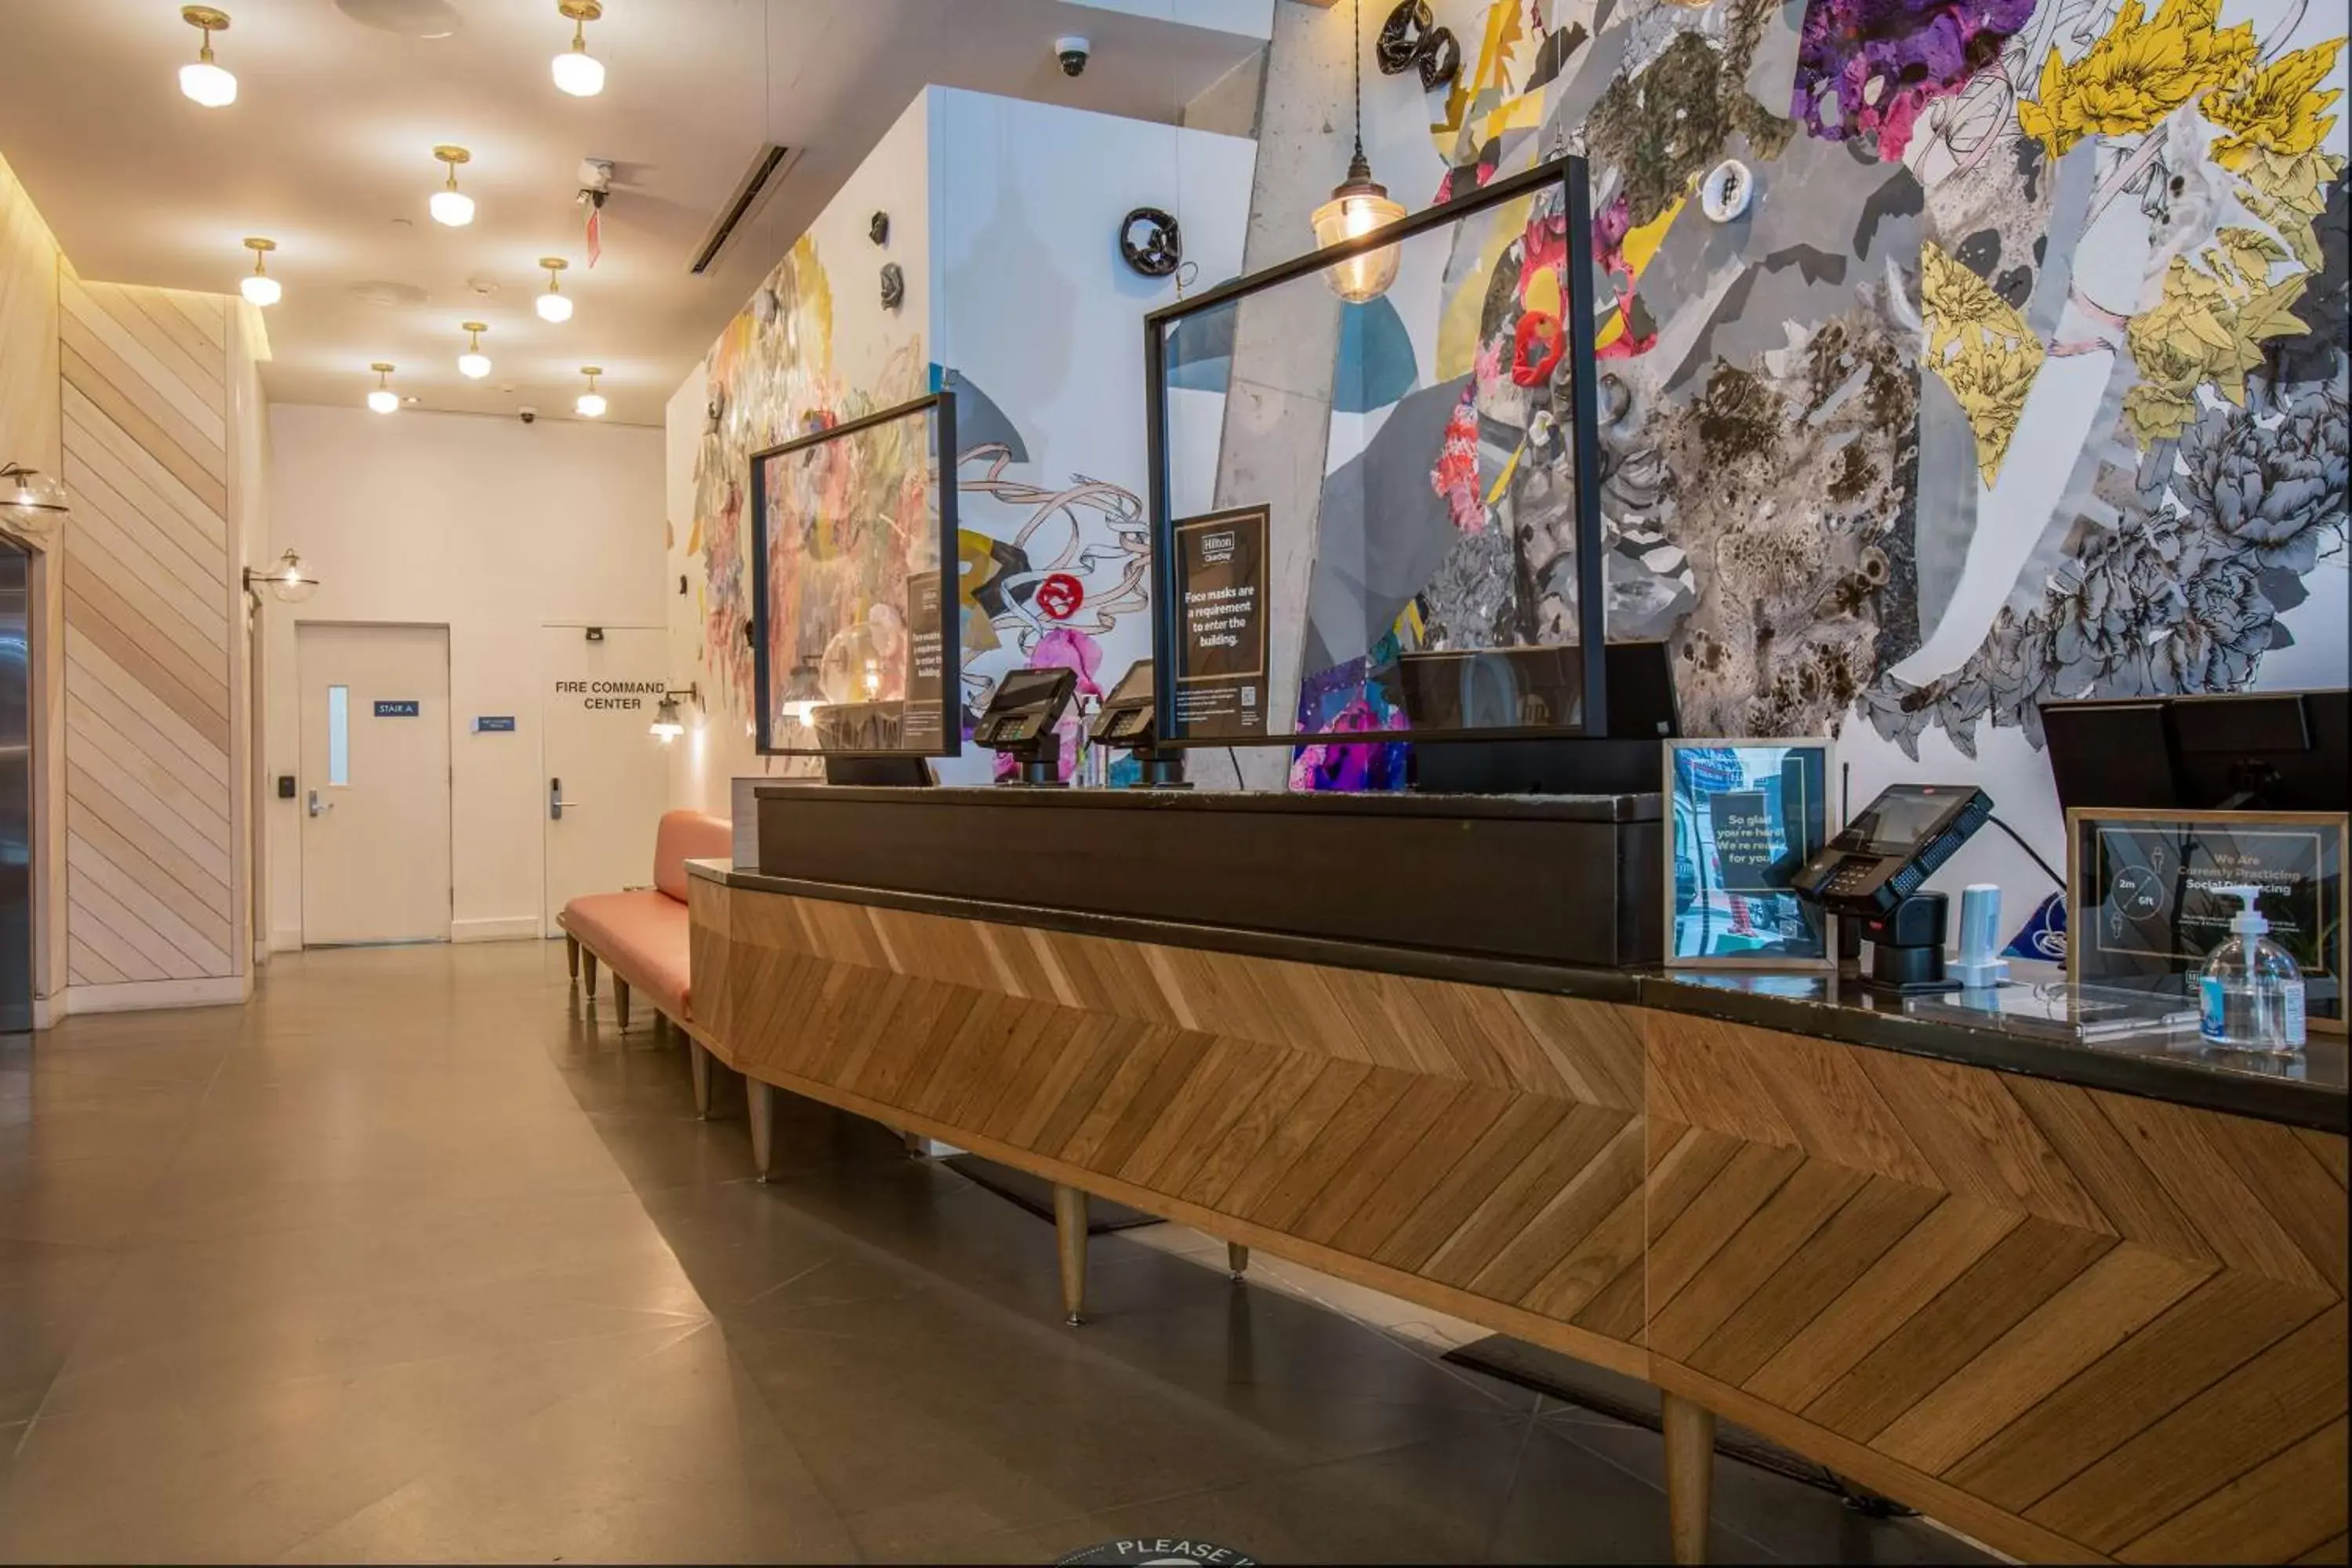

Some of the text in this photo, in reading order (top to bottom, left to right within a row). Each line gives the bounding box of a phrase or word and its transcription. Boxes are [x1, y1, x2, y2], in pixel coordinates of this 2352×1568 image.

[1185, 586, 1254, 603] Face masks are
[1188, 601, 1250, 619] a requirement
[1192, 616, 1246, 632] to enter the
[556, 681, 664, 694] FIRE COMMAND
[584, 699, 641, 710] CENTER
[1729, 815, 1772, 826] So glad
[1717, 826, 1753, 840] you're
[1717, 840, 1751, 851] We're
[1729, 853, 1746, 862] for
[2214, 853, 2260, 865] We Are
[2177, 866, 2301, 882] Currently Practicing
[2119, 879, 2136, 888] 2m
[2186, 879, 2292, 896] Social Dncing
[2139, 896, 2154, 906] 6ft
[1116, 1538, 1232, 1563] PLEASE
